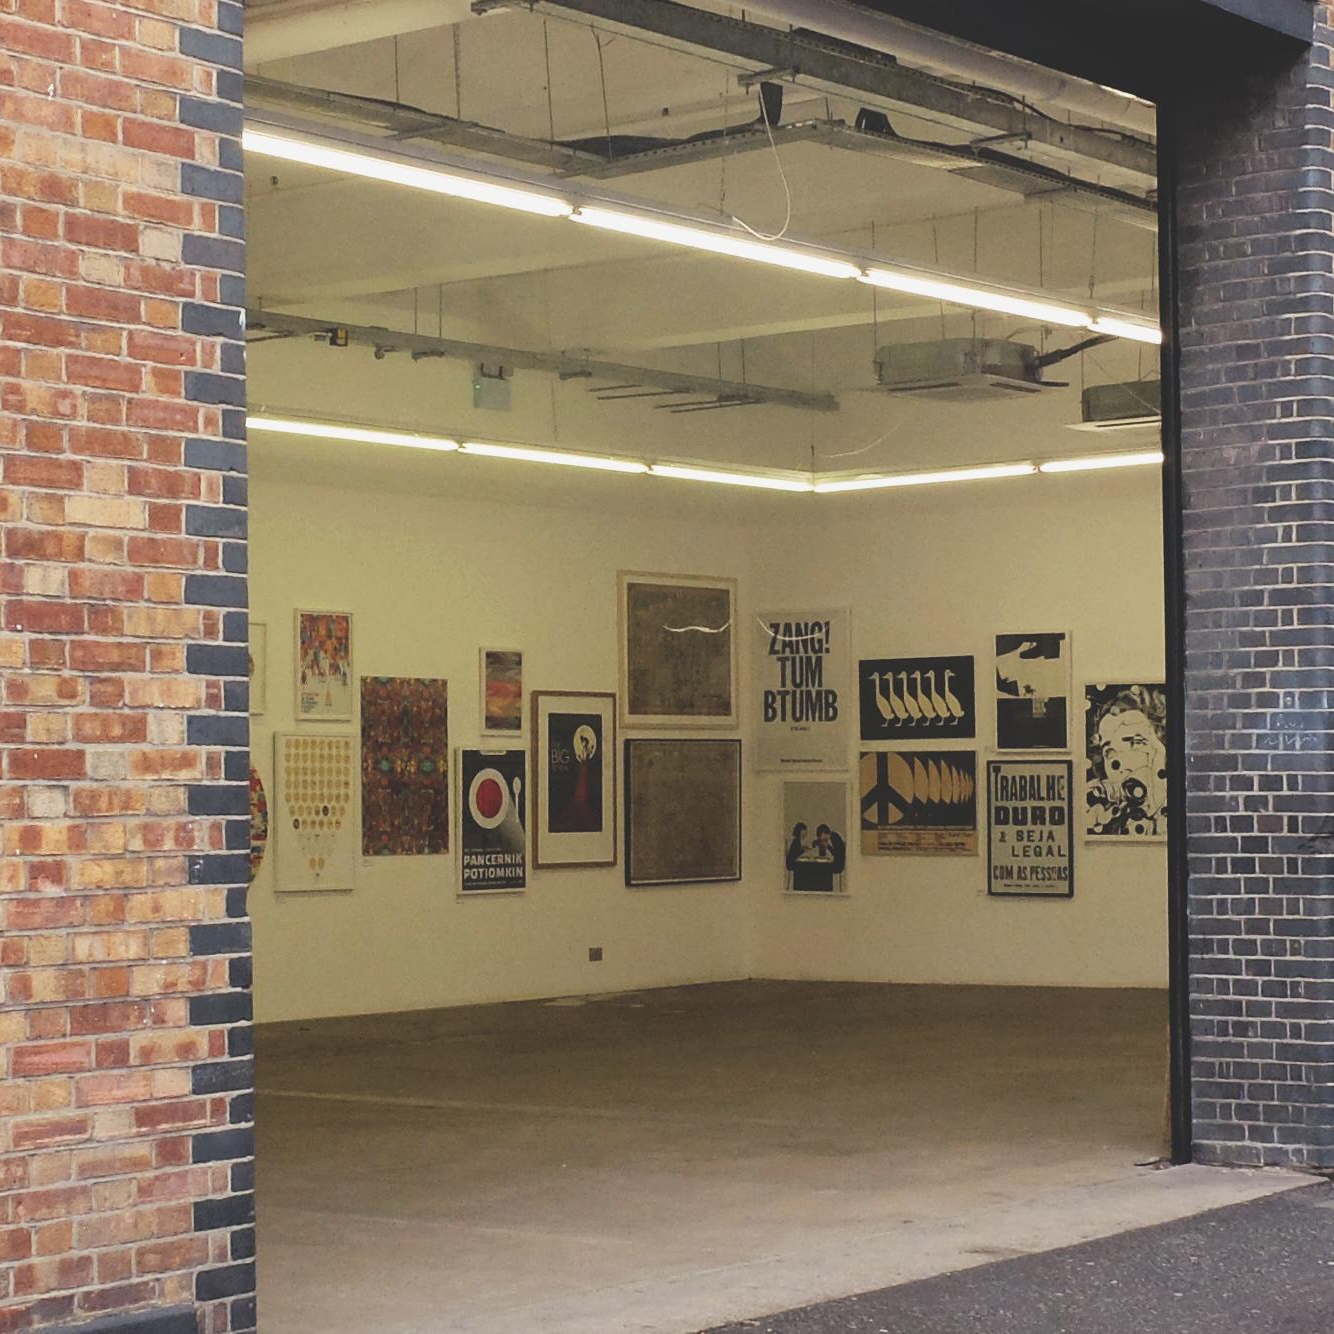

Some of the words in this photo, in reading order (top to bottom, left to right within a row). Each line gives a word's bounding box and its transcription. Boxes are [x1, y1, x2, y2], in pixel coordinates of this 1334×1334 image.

[768, 621, 830, 655] ZANG!
[776, 655, 824, 689] TUM
[763, 688, 838, 723] BTUMB
[992, 765, 1065, 802] TRABALHE
[994, 805, 1065, 826] DURO
[1016, 830, 1055, 842] SEJA
[464, 853, 522, 866] PANCERNIK
[1011, 845, 1067, 858] LEGAL
[464, 866, 523, 880] POTIOMKIN
[993, 865, 1014, 881] COM
[1017, 866, 1028, 881] AS
